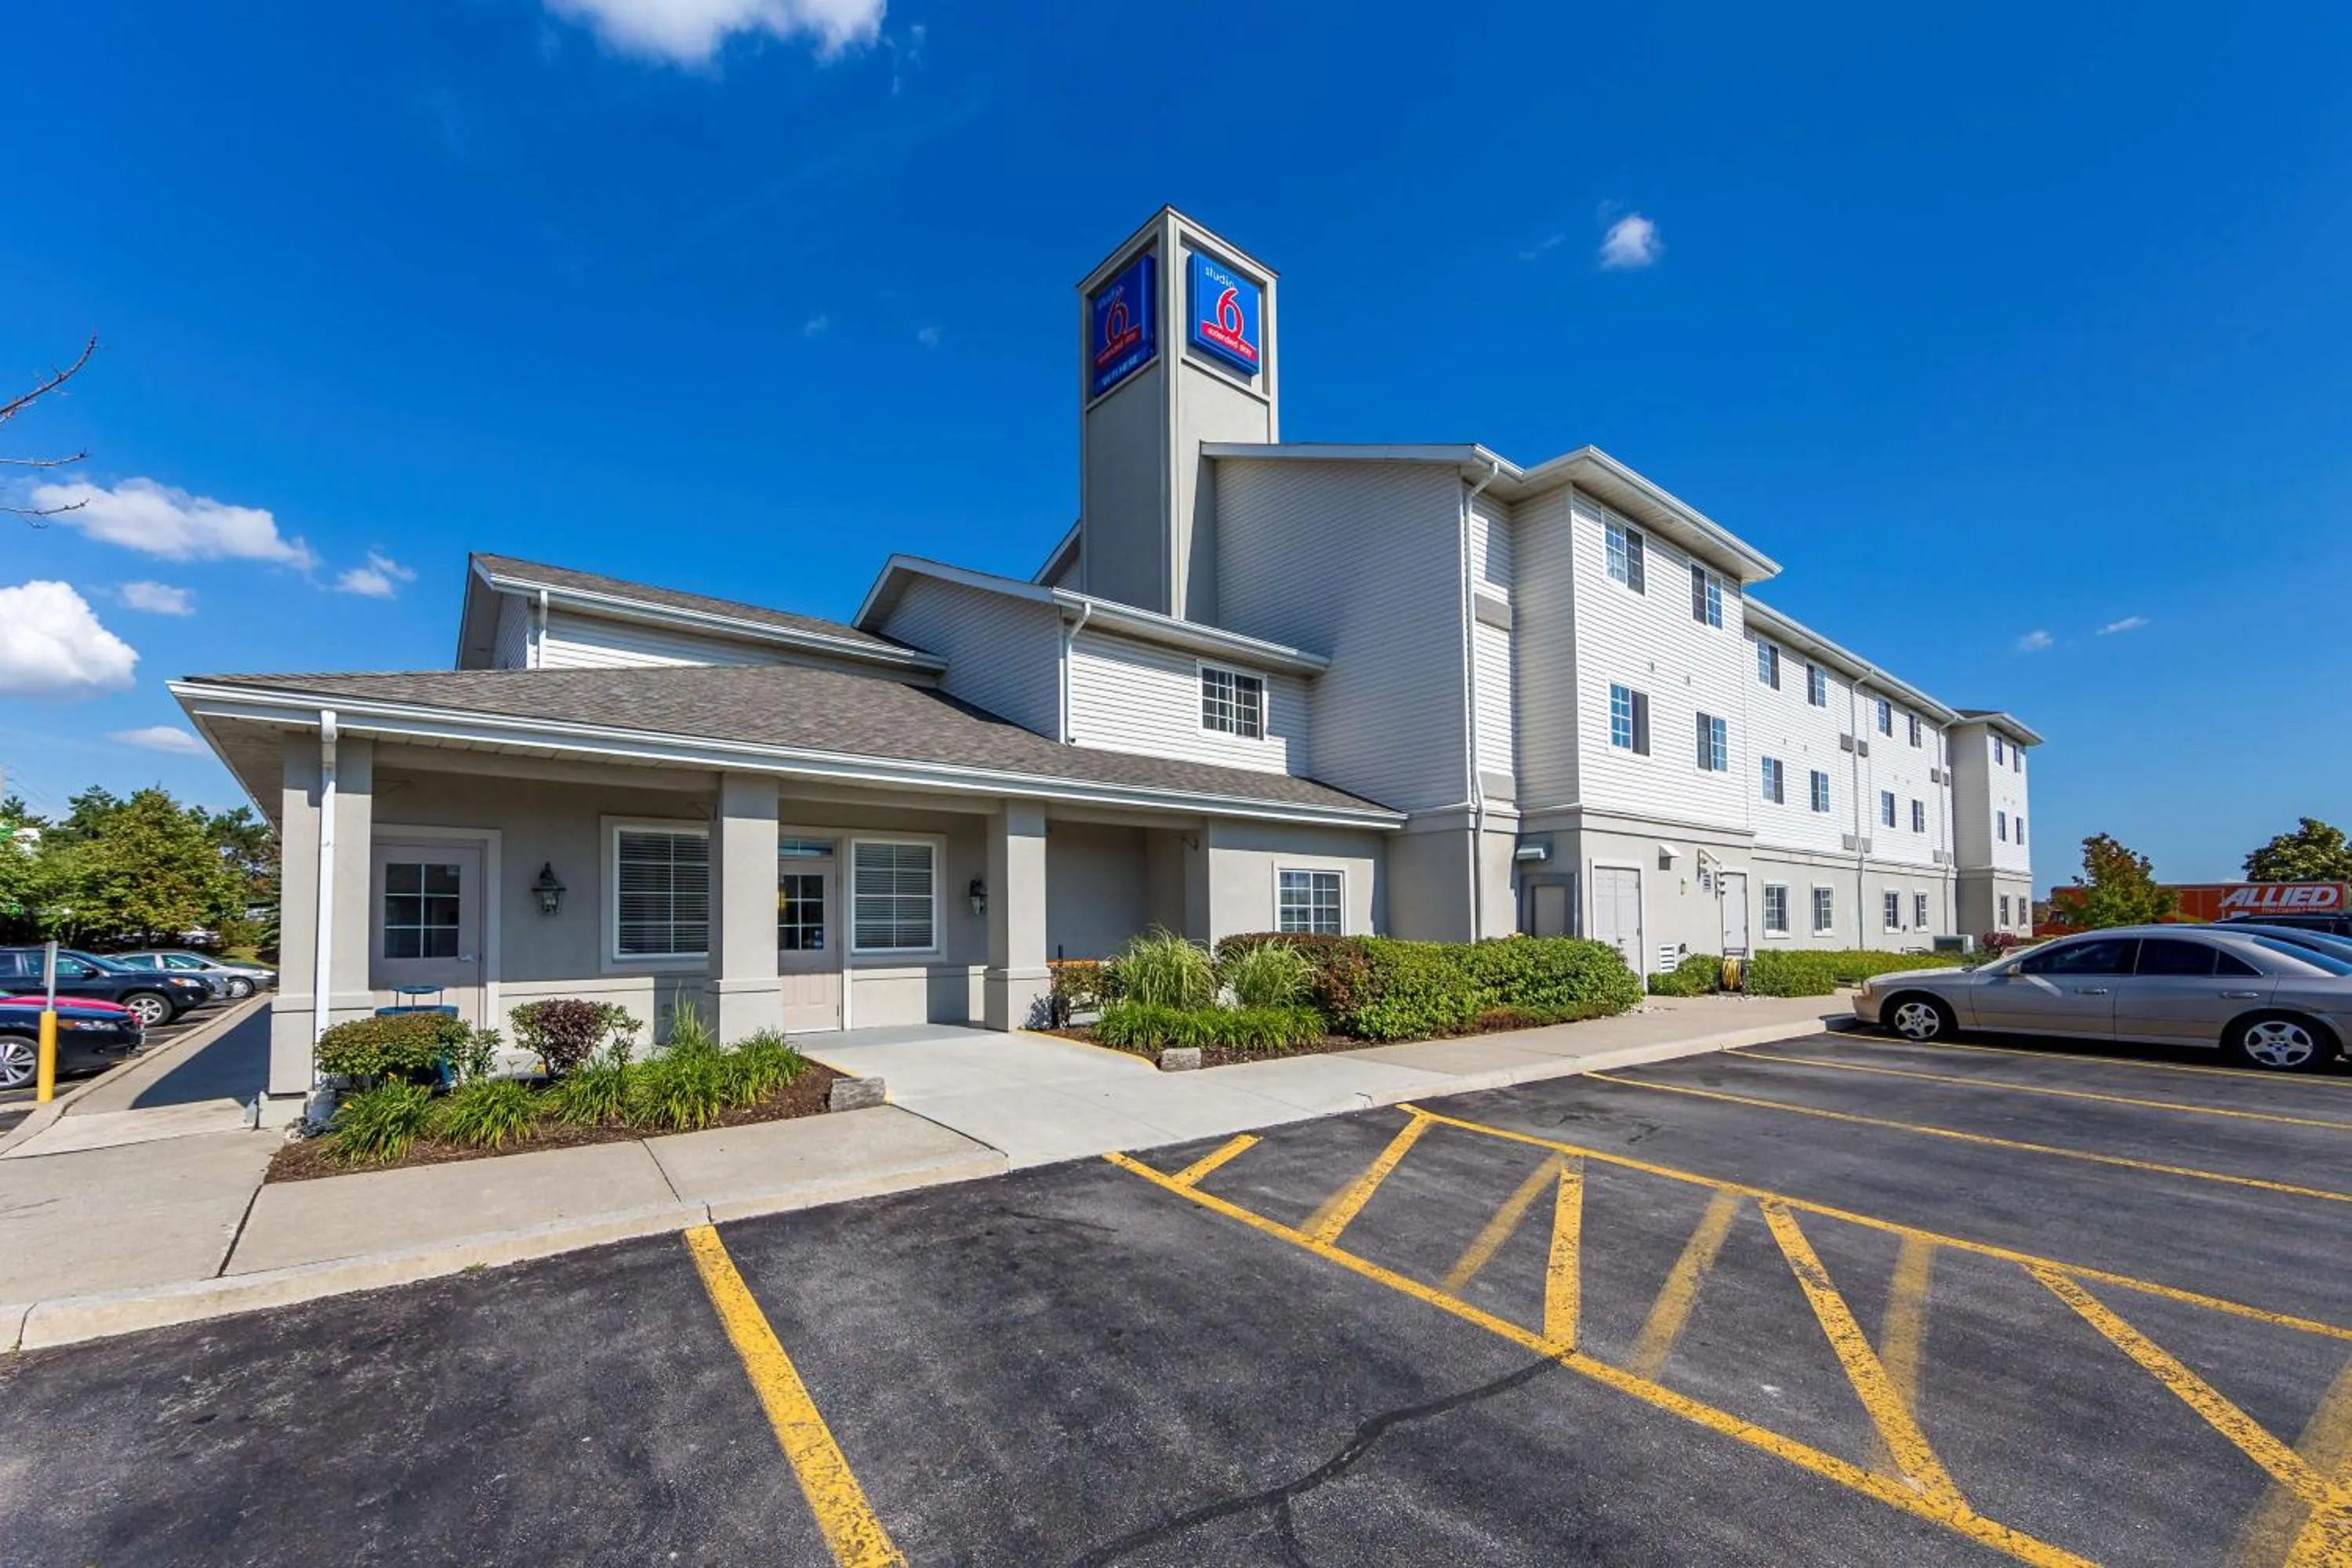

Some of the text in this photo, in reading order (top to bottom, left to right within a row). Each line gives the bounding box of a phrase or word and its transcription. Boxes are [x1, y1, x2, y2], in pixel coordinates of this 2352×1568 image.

[1204, 267, 1235, 289] studio
[1217, 288, 1243, 339] 6
[2219, 887, 2339, 907] ALLIED
